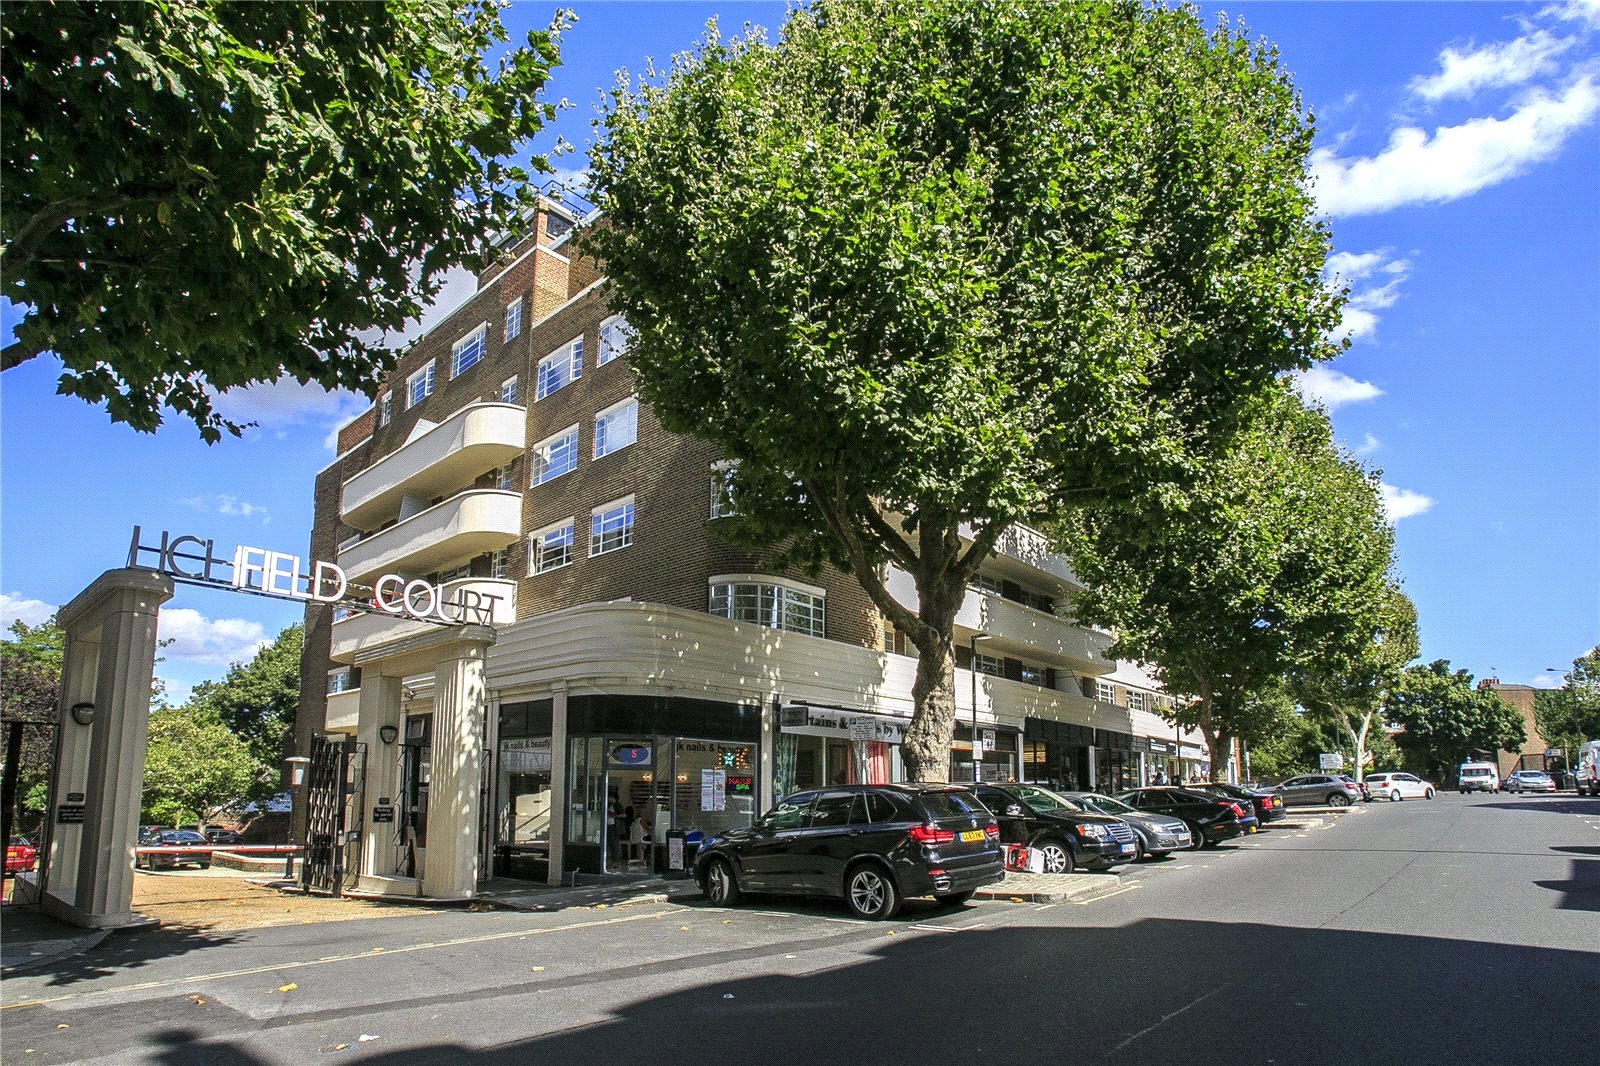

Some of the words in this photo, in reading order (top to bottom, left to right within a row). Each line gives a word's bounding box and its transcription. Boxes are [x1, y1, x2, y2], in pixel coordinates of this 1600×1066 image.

[129, 525, 347, 602] LICHFIELD
[374, 574, 504, 627] COURT
[808, 715, 838, 728] tains
[839, 716, 849, 730] &
[883, 722, 895, 738] by
[511, 740, 524, 750] nails
[531, 739, 550, 750] beauty
[676, 741, 684, 753] jk
[687, 741, 706, 752] nails
[709, 743, 715, 752] &
[728, 777, 752, 785] NAILS
